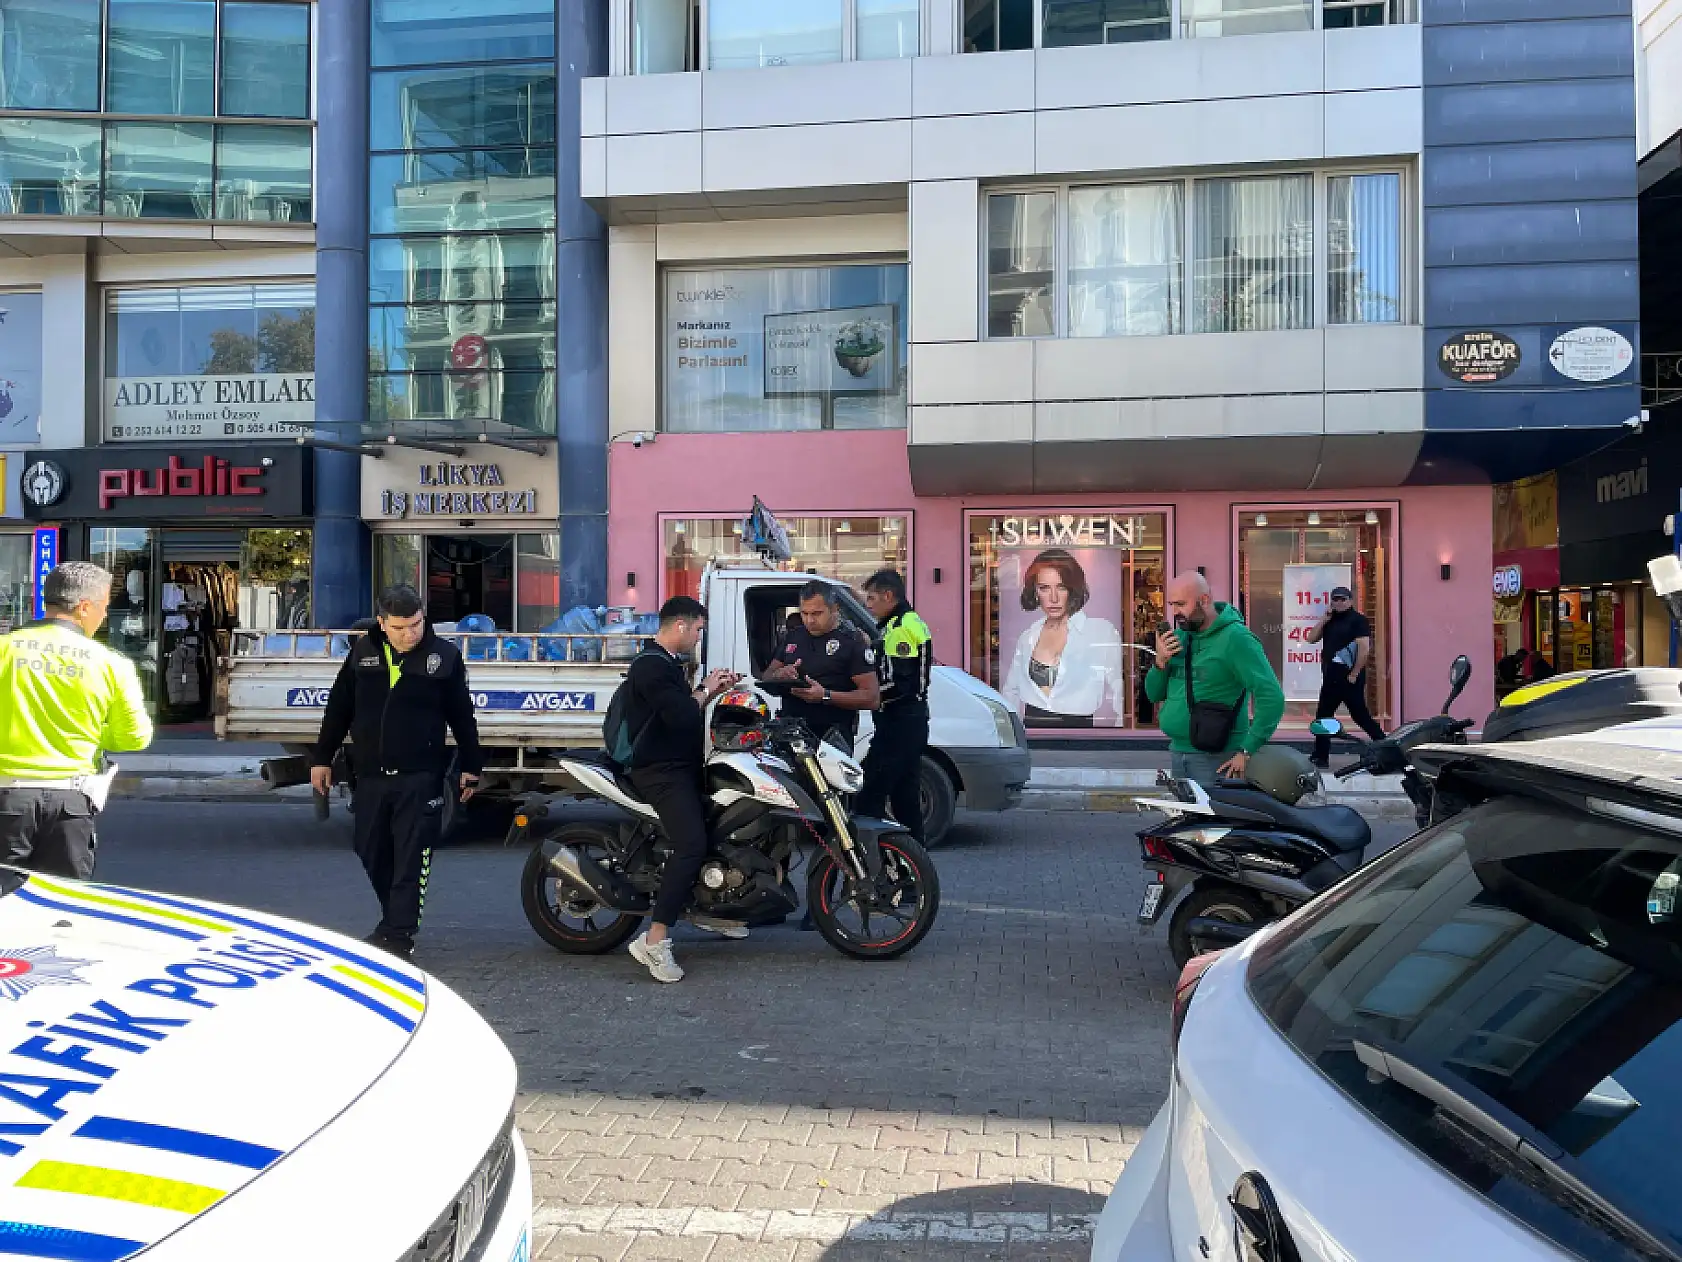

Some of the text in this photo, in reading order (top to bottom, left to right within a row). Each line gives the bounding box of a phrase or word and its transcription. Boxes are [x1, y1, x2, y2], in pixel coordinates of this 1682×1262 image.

[678, 336, 738, 349] Bizimle
[1442, 340, 1517, 361] KUAFÖR
[113, 379, 315, 407] ADLEY EMLAK
[166, 406, 260, 422] Mehmet Özsoy
[100, 455, 265, 510] public
[418, 462, 504, 486] LİKYA
[1597, 457, 1648, 503] mavi
[381, 488, 536, 518] İŞ MERKEZİ
[1002, 516, 1134, 546] SUWEN
[292, 689, 330, 706] AYG
[520, 691, 587, 710] AYGAZ
